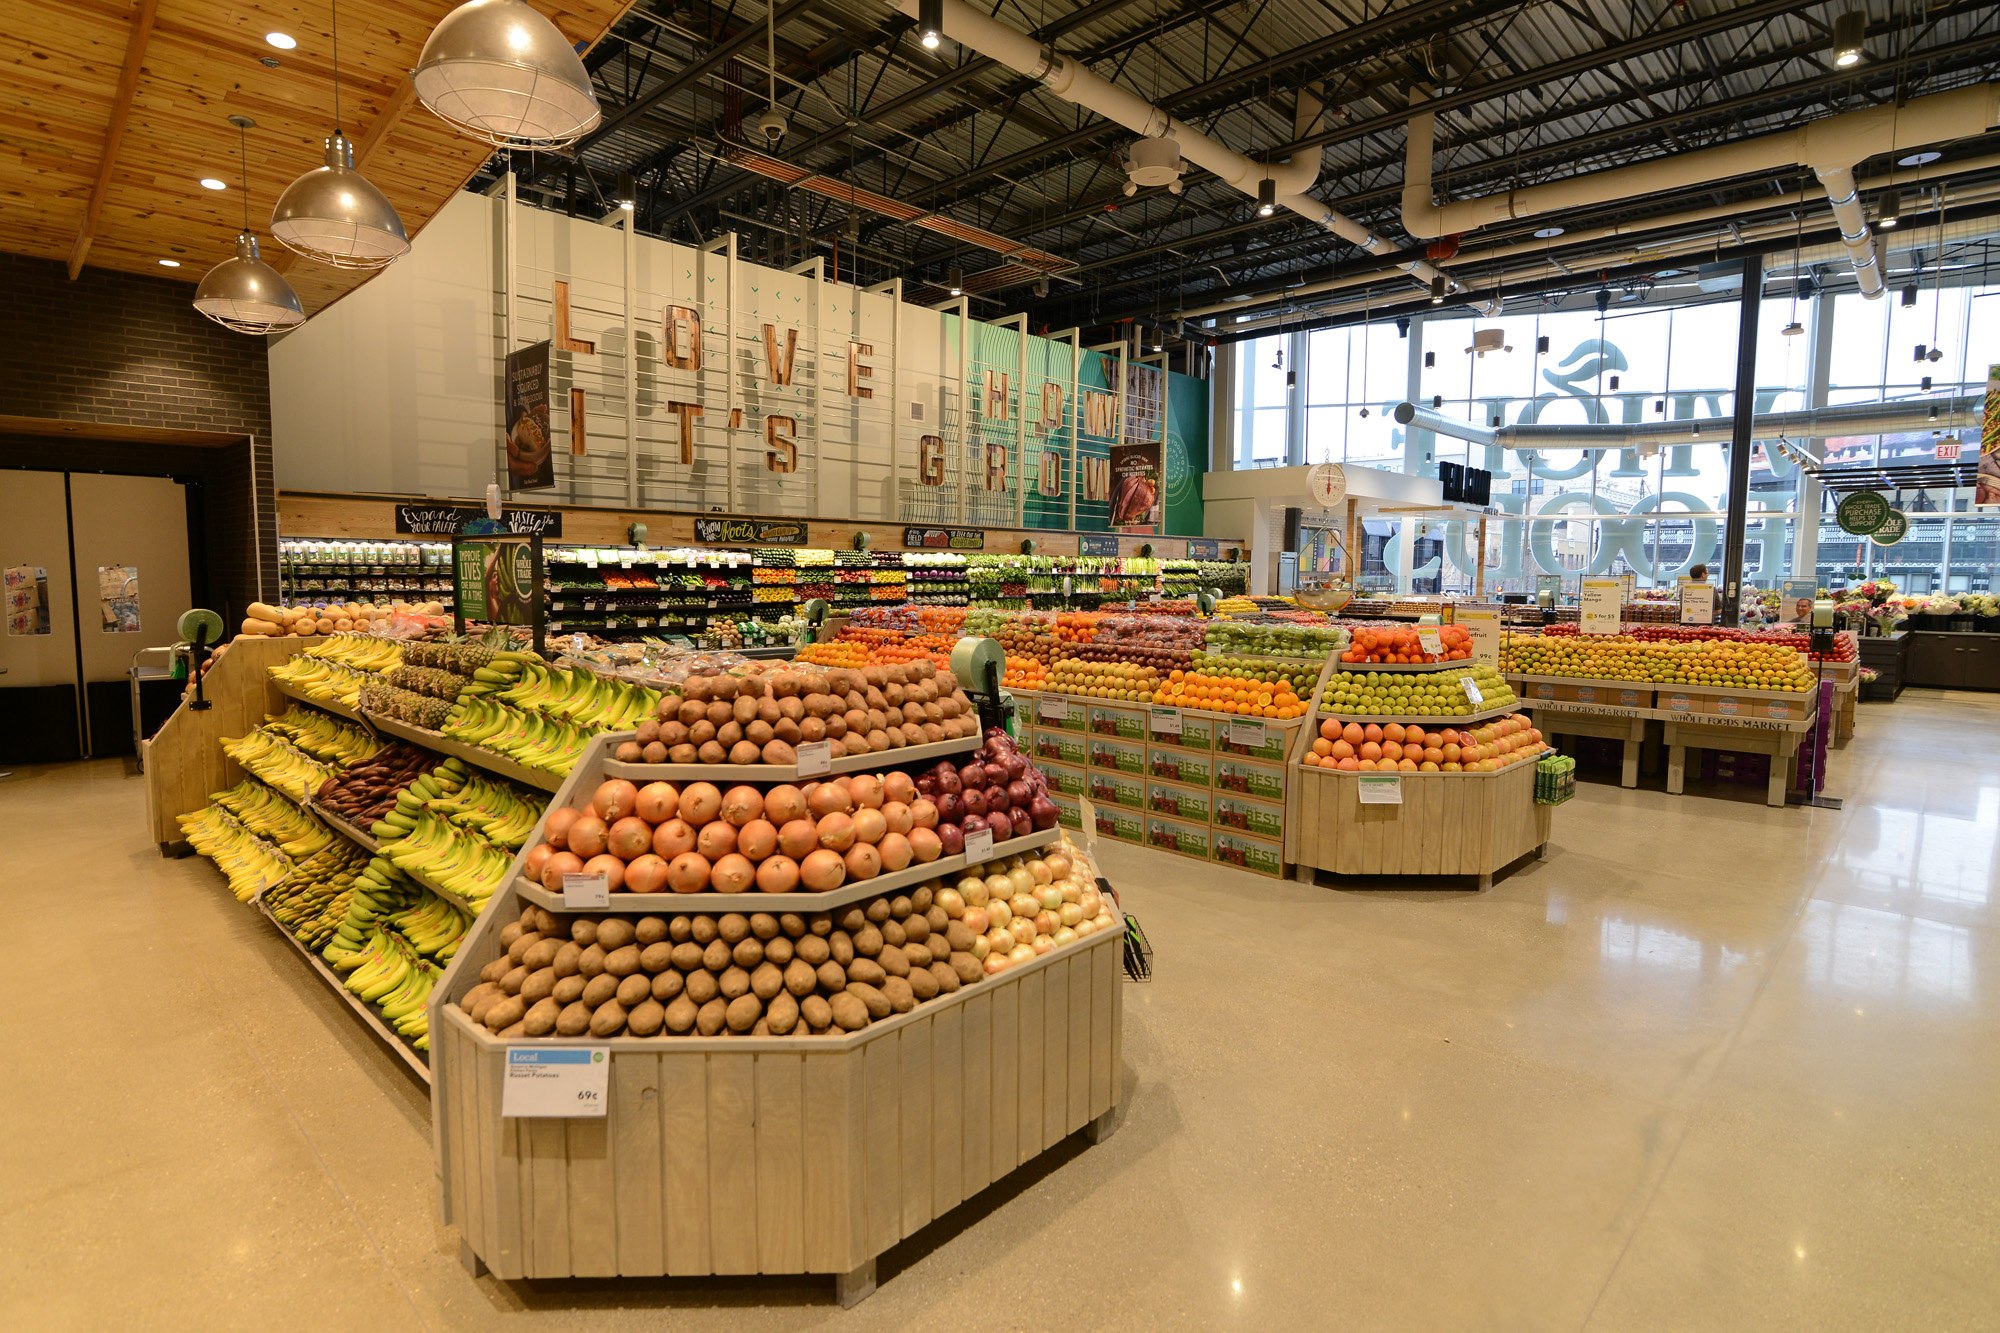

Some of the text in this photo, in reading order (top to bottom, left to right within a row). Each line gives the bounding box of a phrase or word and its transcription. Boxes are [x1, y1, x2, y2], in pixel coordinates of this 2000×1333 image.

[553, 280, 1118, 438] LOVE HOW
[567, 387, 798, 473] IT'S
[1937, 445, 1959, 457] EXIT
[402, 507, 461, 524] Expand
[510, 511, 536, 524] TASTE
[411, 523, 430, 533] YOUR
[701, 522, 721, 538] KNOW
[721, 521, 753, 541] Roots
[459, 550, 480, 561] IMPROVE
[460, 562, 481, 580] LIVES
[462, 590, 482, 601] AT A TIME
[1019, 705, 1030, 715] ST
[1067, 711, 1084, 721] EST
[1537, 702, 1640, 718] WHOLE FOODS MARKET
[1115, 717, 1143, 730] BEST
[1671, 713, 1791, 731] WHOLE FOODS MARKET
[1018, 736, 1030, 746] ST
[1059, 741, 1084, 755] BEST
[1266, 738, 1281, 750] ST
[1115, 751, 1142, 765] BEST
[1178, 761, 1209, 774] BEST
[1058, 774, 1083, 786] BEST
[1247, 773, 1281, 788] BEST
[1115, 784, 1142, 798] BEST
[1177, 796, 1207, 810] BEST
[1113, 817, 1141, 831] BEST
[1246, 810, 1280, 825] BEST
[1175, 831, 1206, 846] BEST
[1245, 846, 1278, 864] BEST
[513, 1053, 528, 1062] Local
[578, 1091, 598, 1100] 69¢
